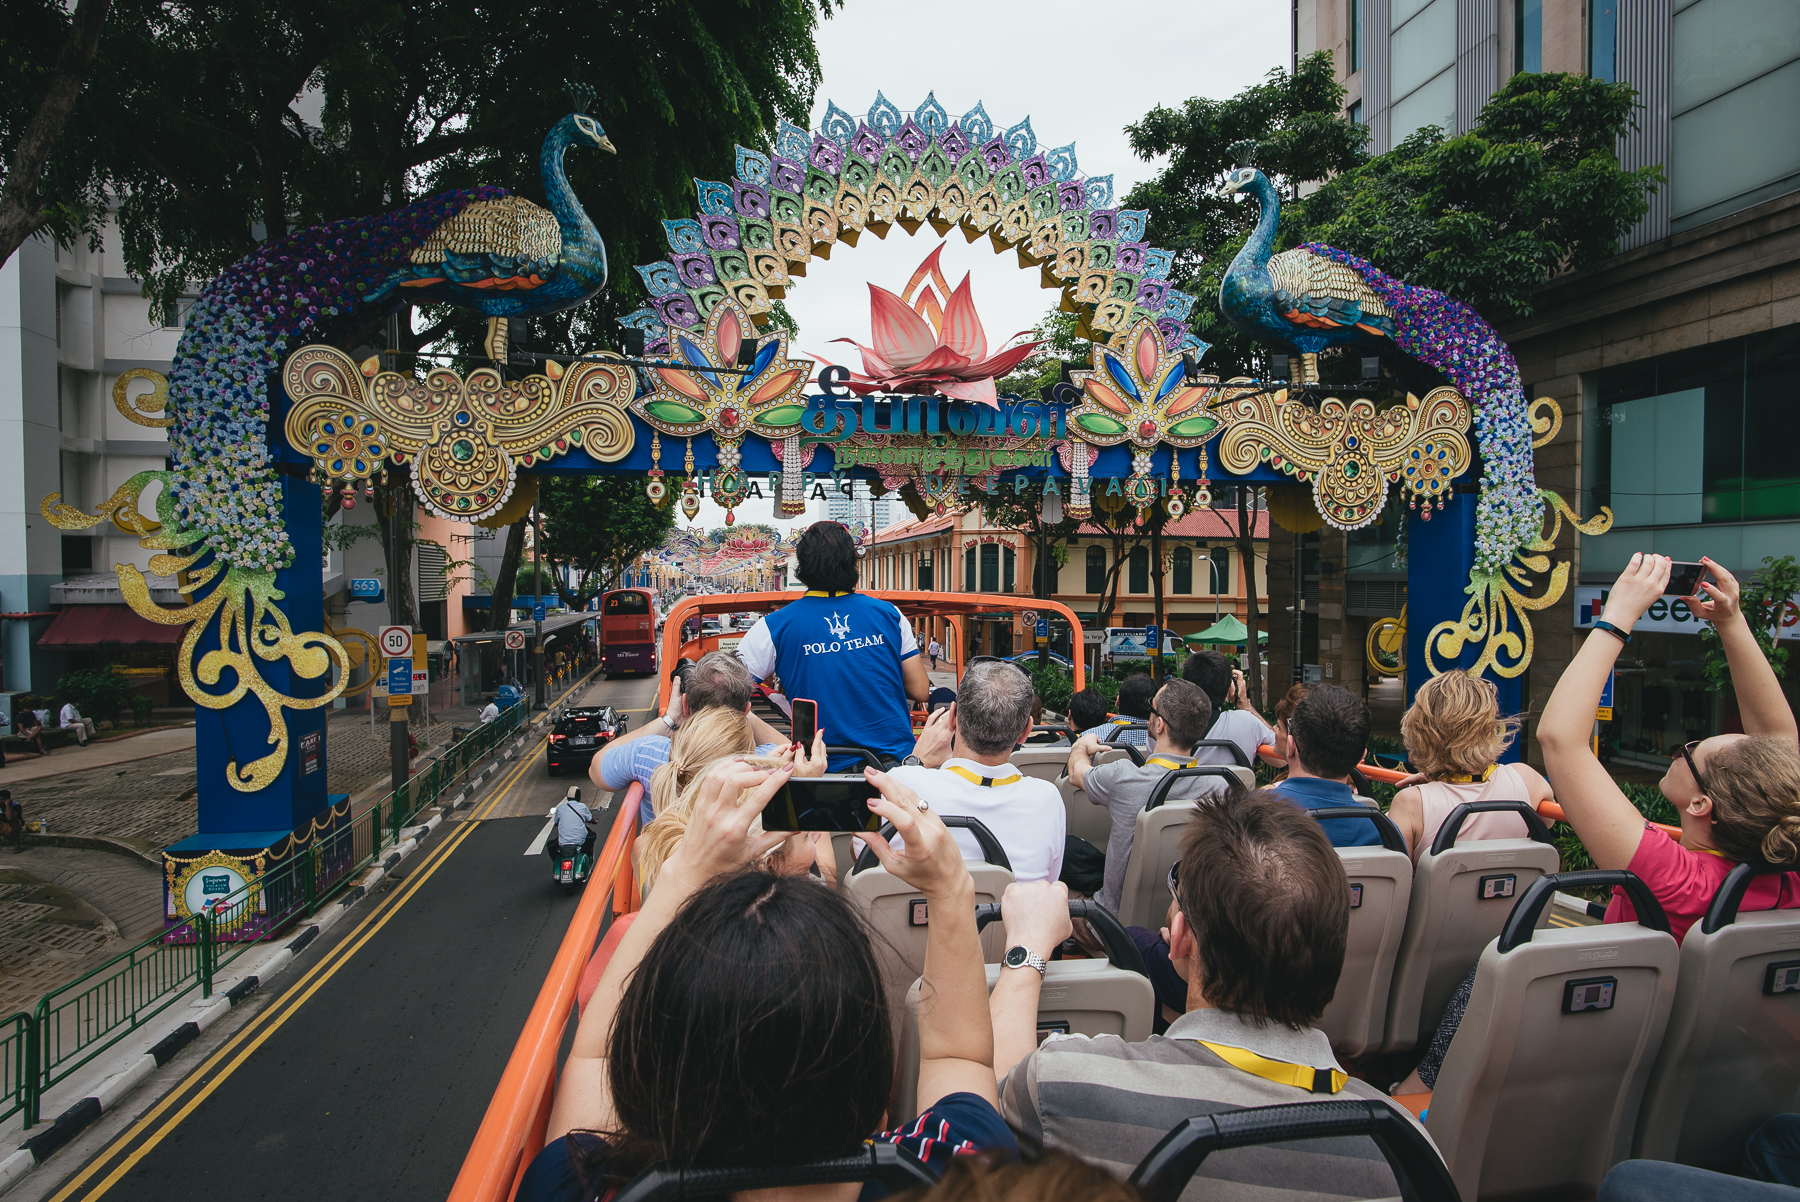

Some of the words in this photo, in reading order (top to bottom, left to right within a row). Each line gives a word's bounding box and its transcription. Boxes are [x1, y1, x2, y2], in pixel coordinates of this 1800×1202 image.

[697, 469, 846, 492] HAPPY
[926, 474, 1168, 497] DEEPAVALI
[353, 581, 376, 591] 663
[610, 599, 619, 607] 23
[389, 635, 403, 647] 50
[803, 642, 841, 656] POLO
[843, 634, 885, 651] TEAM
